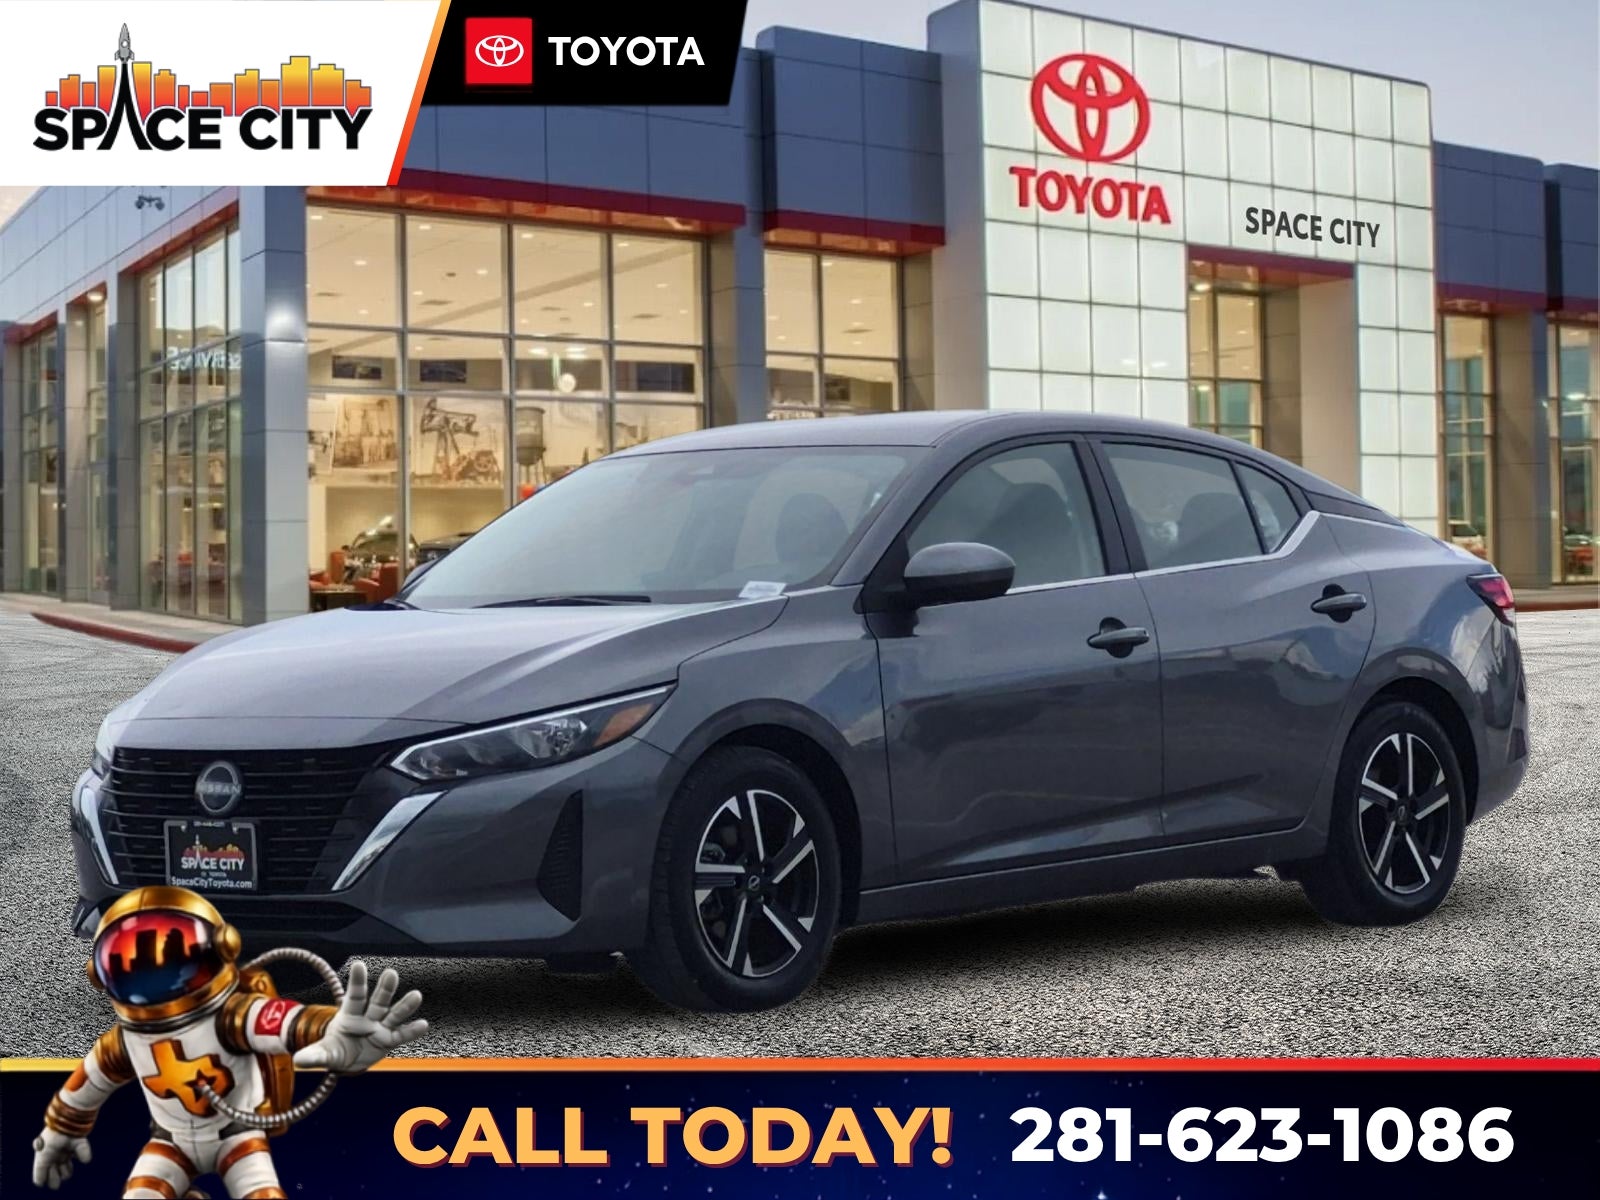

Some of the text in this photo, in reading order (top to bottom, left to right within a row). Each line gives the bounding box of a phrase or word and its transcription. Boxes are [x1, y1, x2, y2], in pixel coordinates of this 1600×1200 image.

[1009, 166, 1171, 224] TOYOTA
[1245, 206, 1381, 248] SPACE CITY
[181, 856, 245, 871] SPACE CITY
[171, 876, 253, 889] SpaceCityToyota.com
